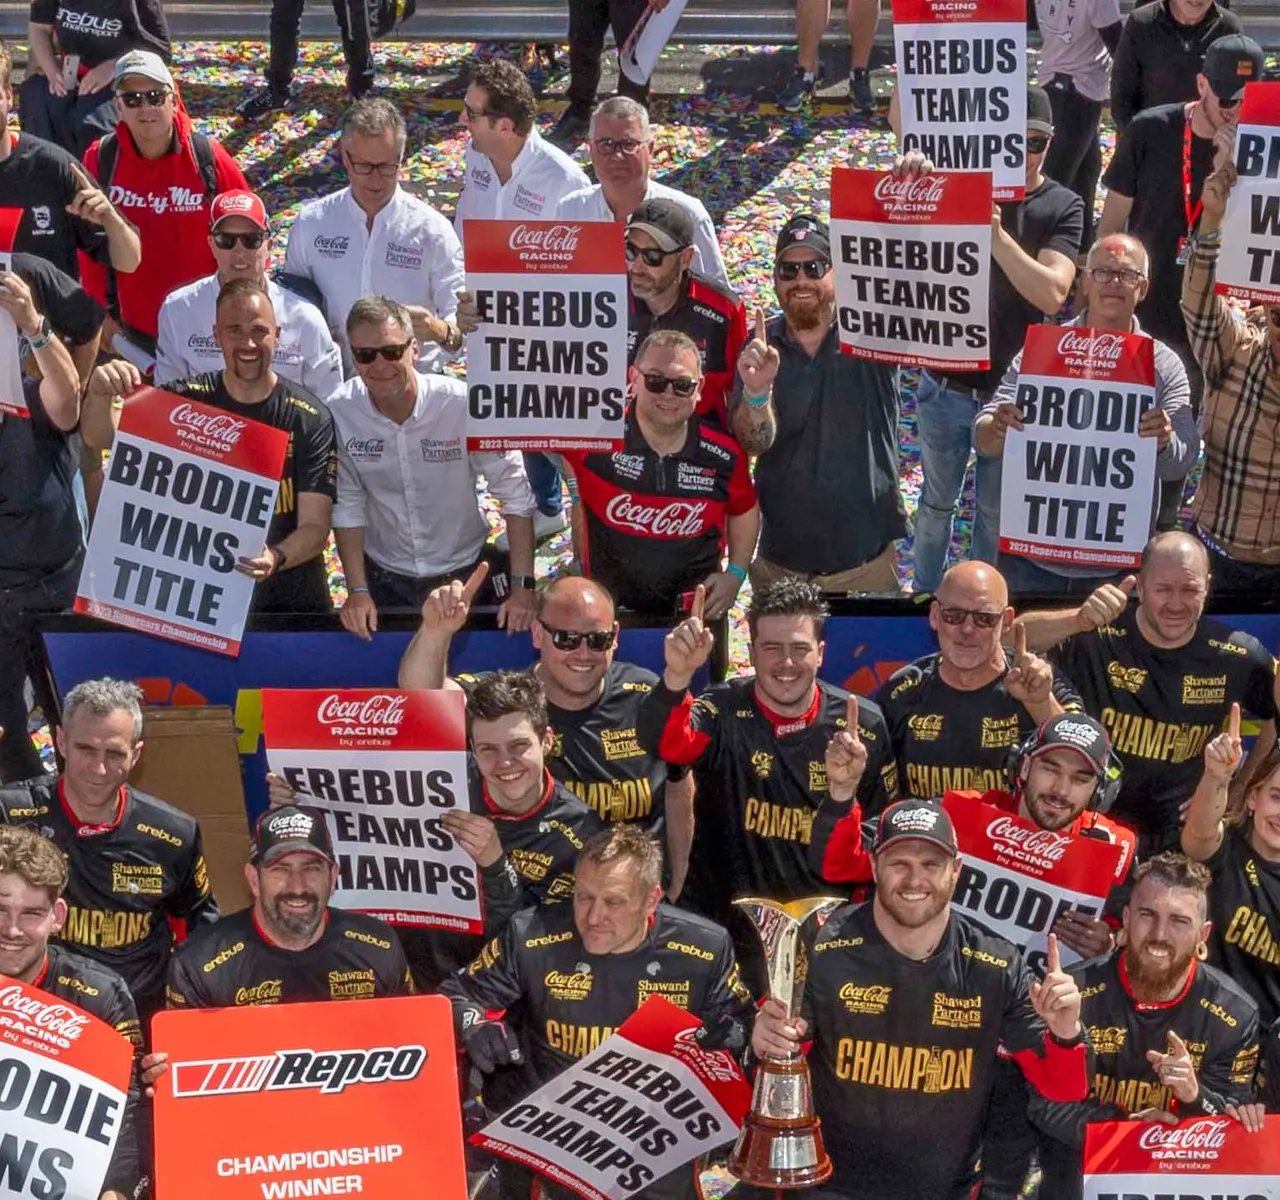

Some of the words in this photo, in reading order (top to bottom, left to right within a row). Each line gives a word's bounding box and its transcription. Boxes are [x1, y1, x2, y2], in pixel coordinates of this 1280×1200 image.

[62, 21, 120, 38] motorsport
[903, 38, 1017, 75] EREBUS
[911, 86, 1009, 123] TEAMS
[169, 186, 203, 205] Mo
[874, 174, 948, 202] Coca-Cola
[884, 202, 937, 212] RACING
[509, 224, 581, 251] Coca-Cola
[519, 253, 573, 261] RACING
[841, 234, 980, 277] EREBUS
[851, 274, 971, 315] TEAMS
[1228, 287, 1249, 299] 2023
[475, 290, 617, 328] EREBUS
[839, 306, 988, 349] CHAMPS
[485, 336, 608, 376] TEAMS
[1058, 330, 1126, 358] Coca-Cola
[1065, 358, 1116, 369] RACING
[470, 384, 624, 422] CHAMPS
[170, 403, 247, 442] Coca-Cola
[176, 429, 232, 452] RACING
[479, 440, 501, 449] 2023
[502, 439, 547, 450] Supercars
[549, 439, 612, 451] Championship
[1026, 441, 1136, 490] WINS
[109, 441, 273, 529] BRODIE
[606, 494, 708, 536] Coca-Cola
[1024, 494, 1127, 543] TITLE
[120, 502, 240, 574] WINS
[1029, 544, 1073, 559] Supercars
[1073, 549, 1135, 565] Championship
[113, 557, 224, 626] TITLE
[1183, 675, 1226, 686] Shawand
[1183, 686, 1225, 698] Partners
[318, 694, 408, 724] Coca-Cola
[331, 727, 398, 736] RACING
[283, 767, 456, 808] EREBUS
[136, 823, 182, 847] erebus
[986, 817, 1074, 861] Coca-Cola
[112, 863, 162, 875] Shawand
[992, 842, 1053, 870] RACING
[335, 854, 477, 901] HAMPS
[525, 931, 573, 948] erebus
[667, 941, 715, 961] erebus
[815, 937, 863, 951] erebus
[638, 980, 689, 991] Shawand
[839, 982, 892, 1003] Coca-Cola
[0, 1015, 70, 1049] RACING
[266, 1046, 428, 1094] Repco
[583, 1051, 721, 1141] EREBUS
[555, 1080, 678, 1157] TEAMS
[500, 1103, 655, 1192] CHAMPS
[1139, 1120, 1230, 1150] Coca-Cola
[217, 1144, 403, 1176] CHAMPIONSHIP
[1151, 1150, 1219, 1160] RACING
[261, 1175, 363, 1200] WINNER
